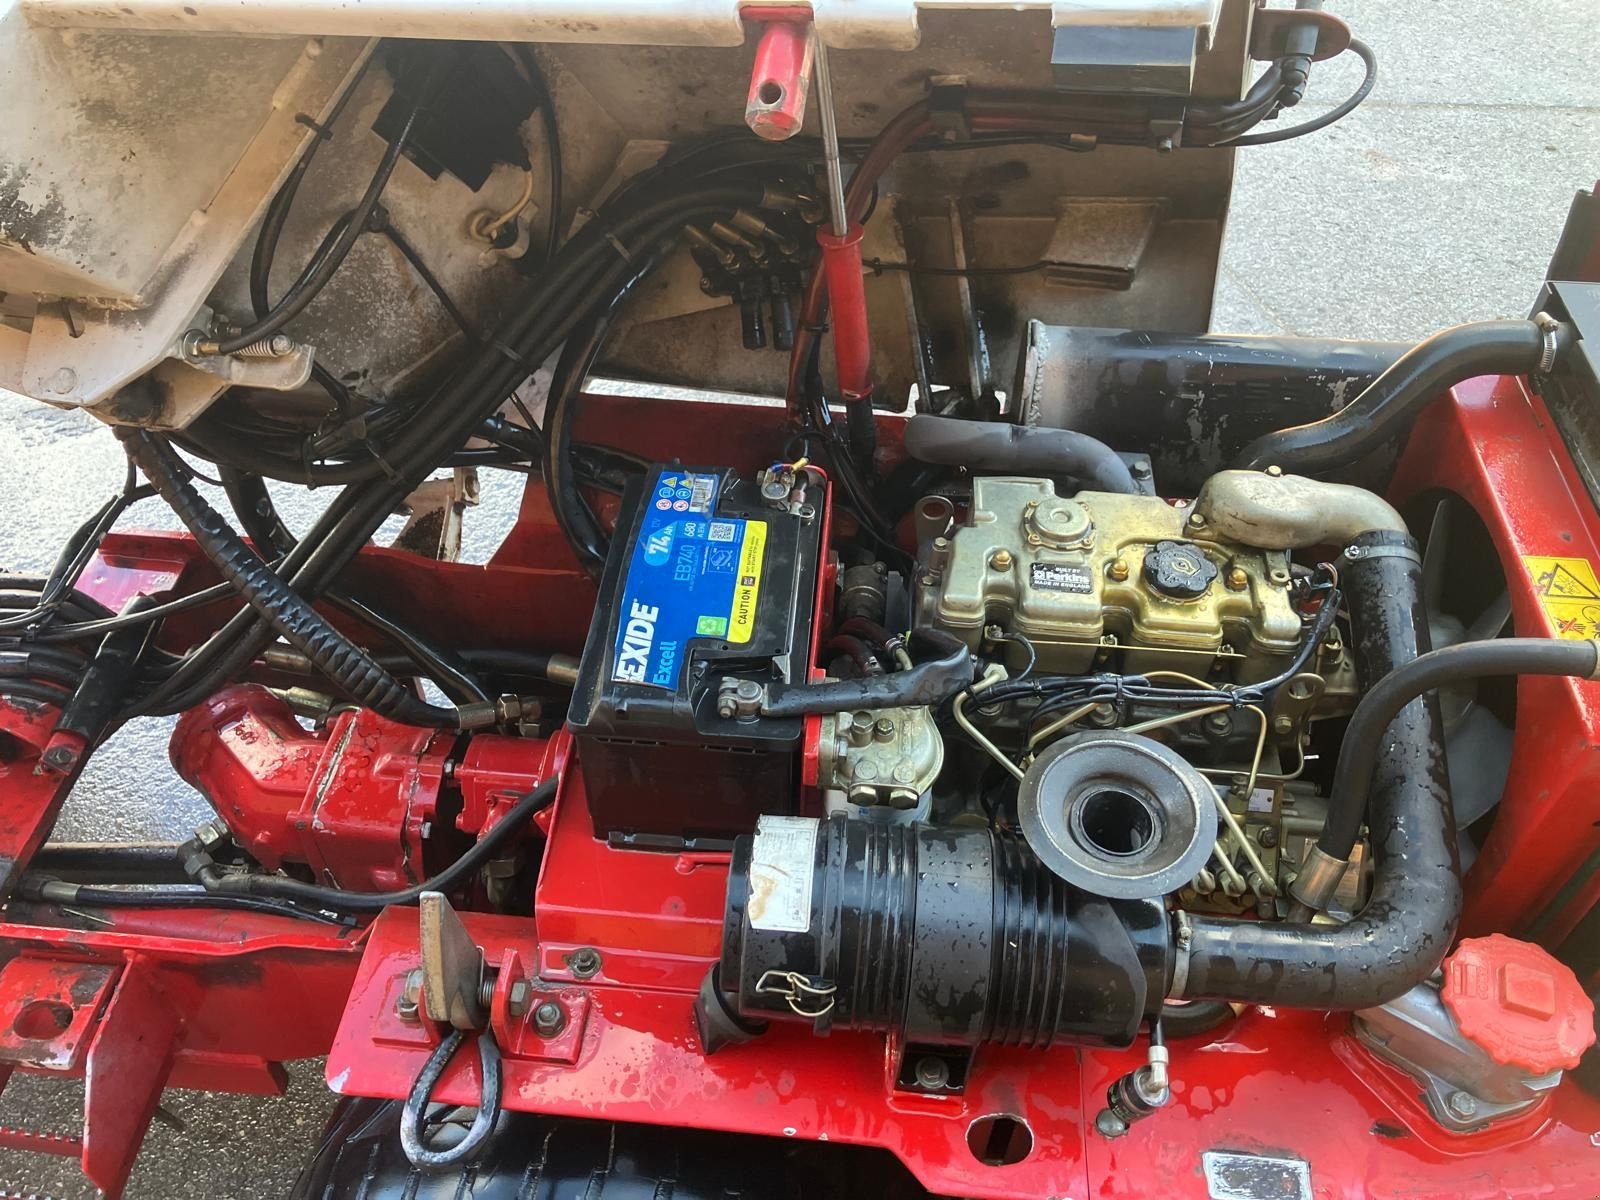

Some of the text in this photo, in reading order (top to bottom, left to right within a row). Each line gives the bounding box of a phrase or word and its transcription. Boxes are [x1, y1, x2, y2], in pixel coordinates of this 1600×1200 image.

[648, 535, 671, 554] 74
[684, 522, 696, 537] 680
[674, 544, 696, 581] EB740
[1046, 571, 1090, 582] Perkins
[738, 589, 752, 625] CAUTION
[615, 602, 660, 683] EXIDE
[653, 640, 677, 685] Excell
